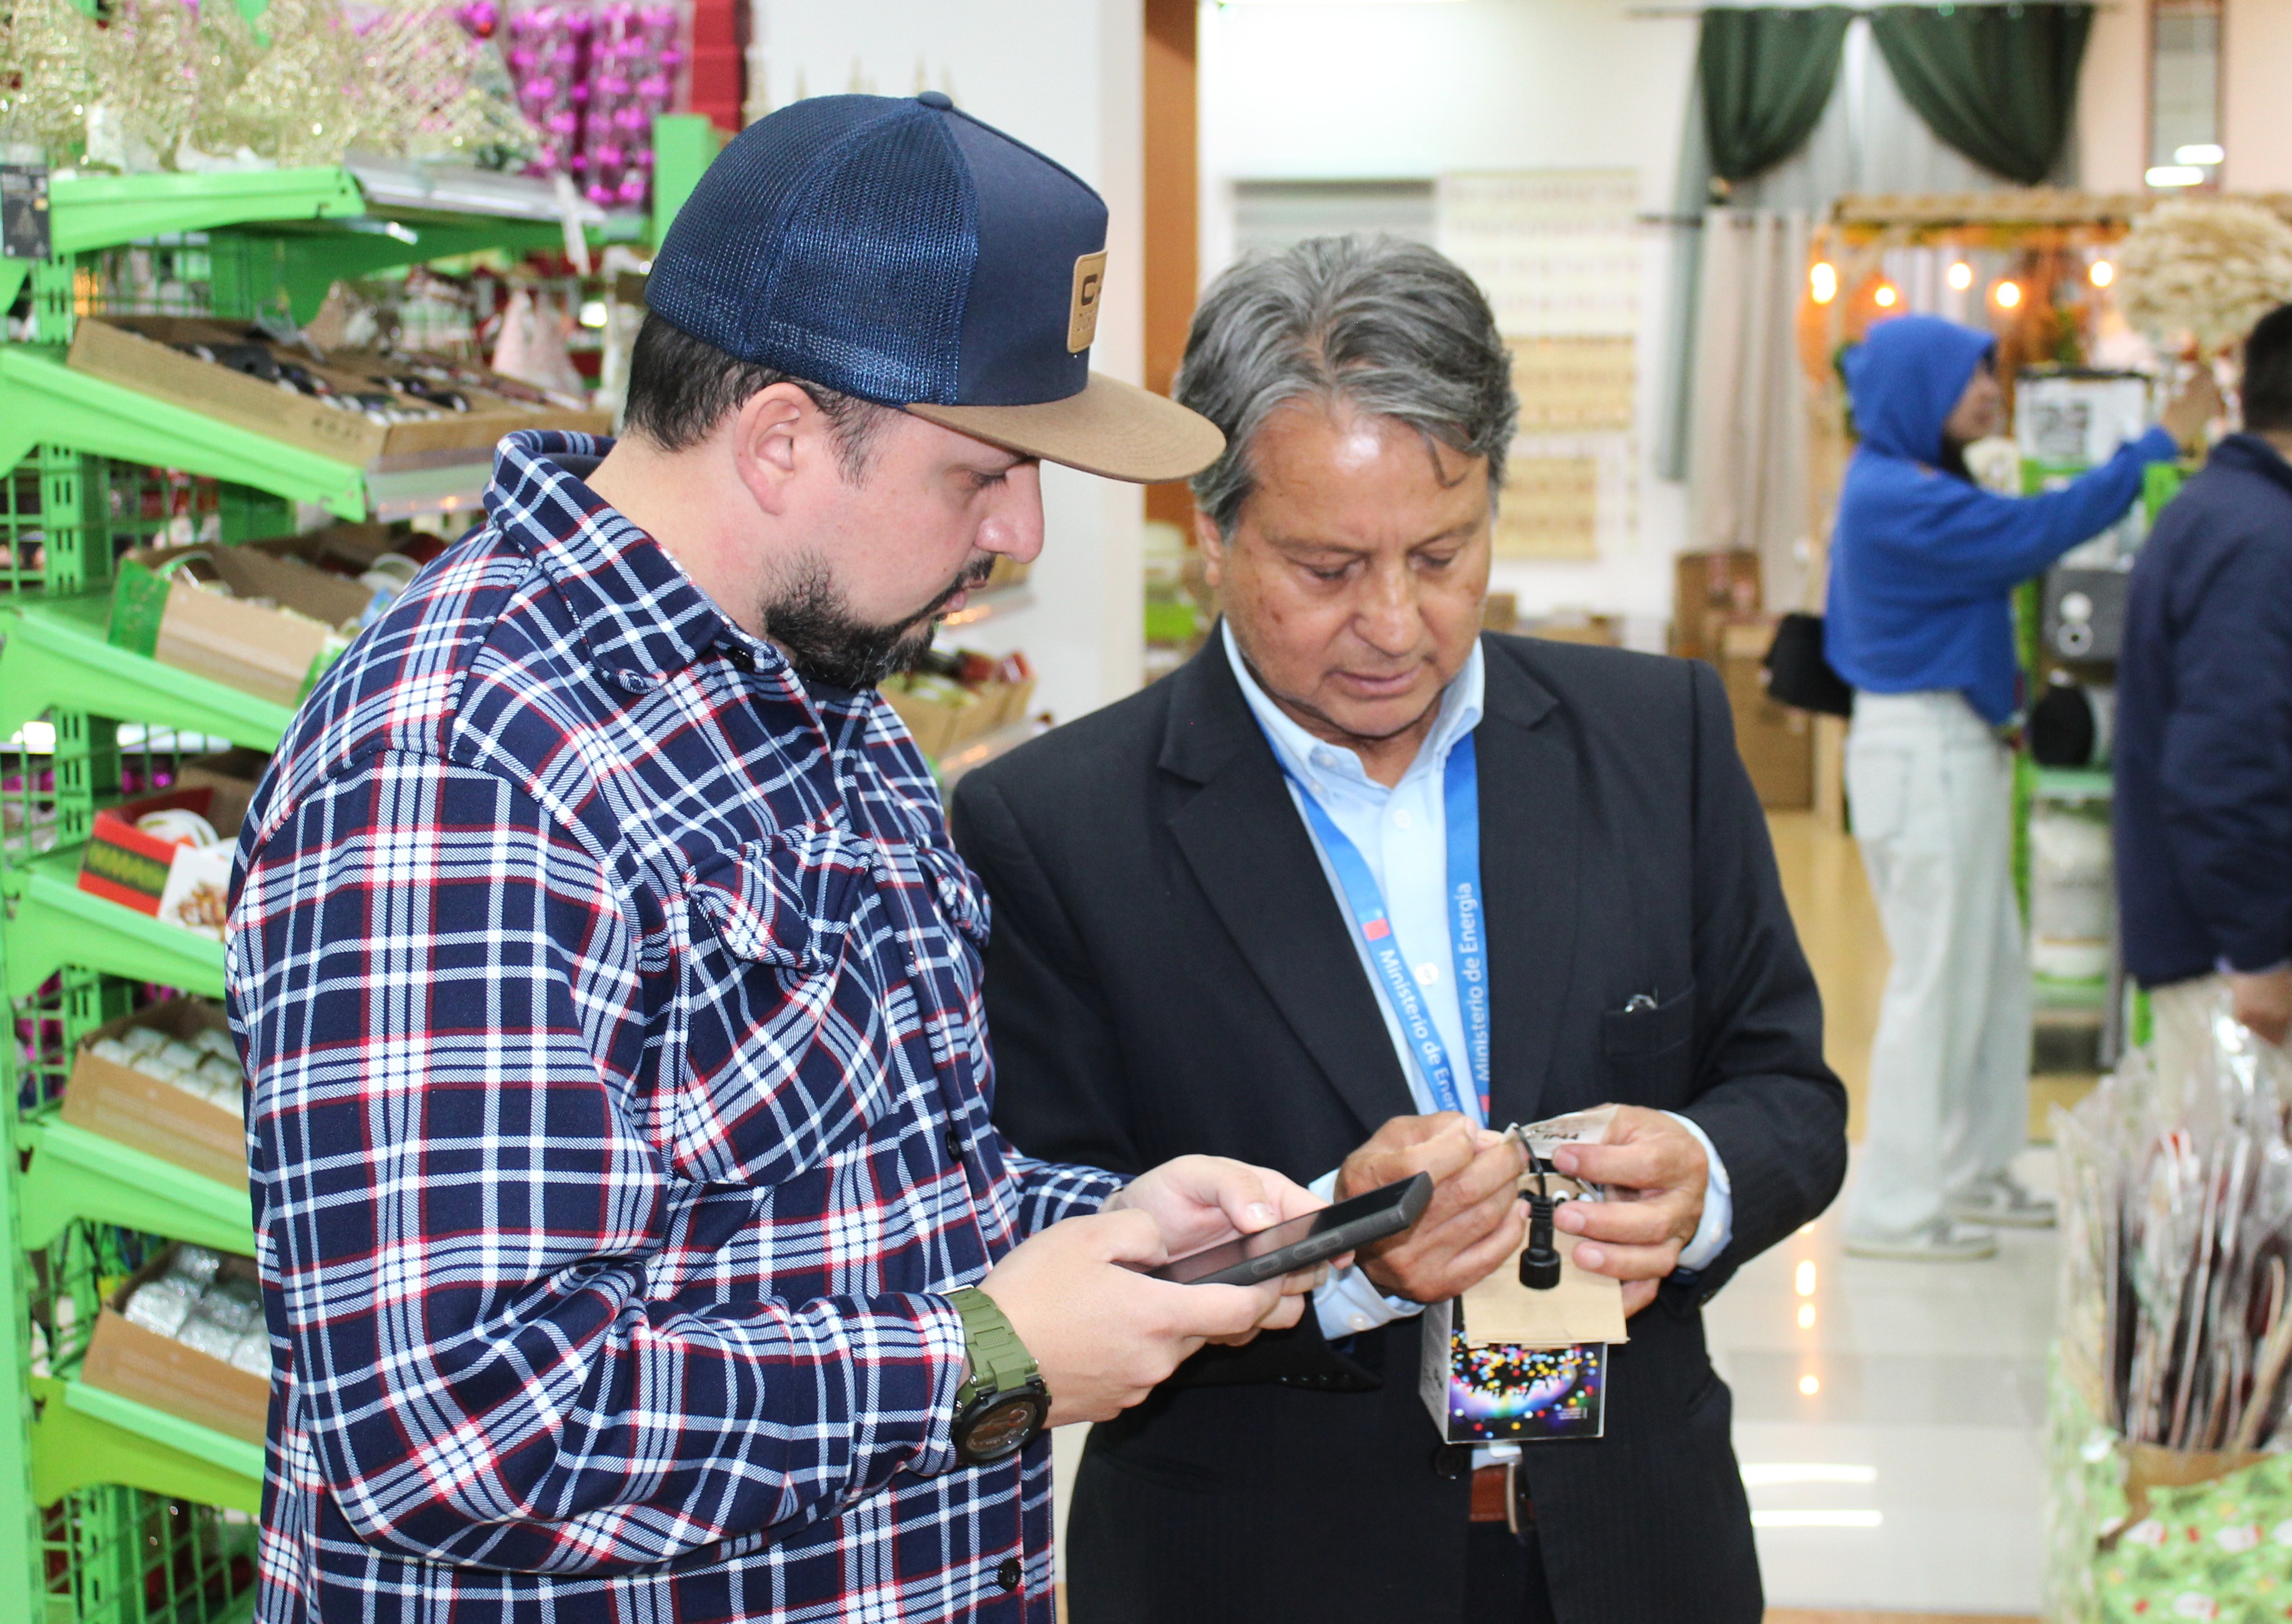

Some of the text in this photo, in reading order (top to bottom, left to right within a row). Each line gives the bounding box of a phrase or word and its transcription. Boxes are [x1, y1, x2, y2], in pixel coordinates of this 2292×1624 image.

[1462, 958, 1482, 982] de
[1379, 949, 1456, 1112] Ministerio de Ener
[1467, 985, 1491, 1082] Ministerio
